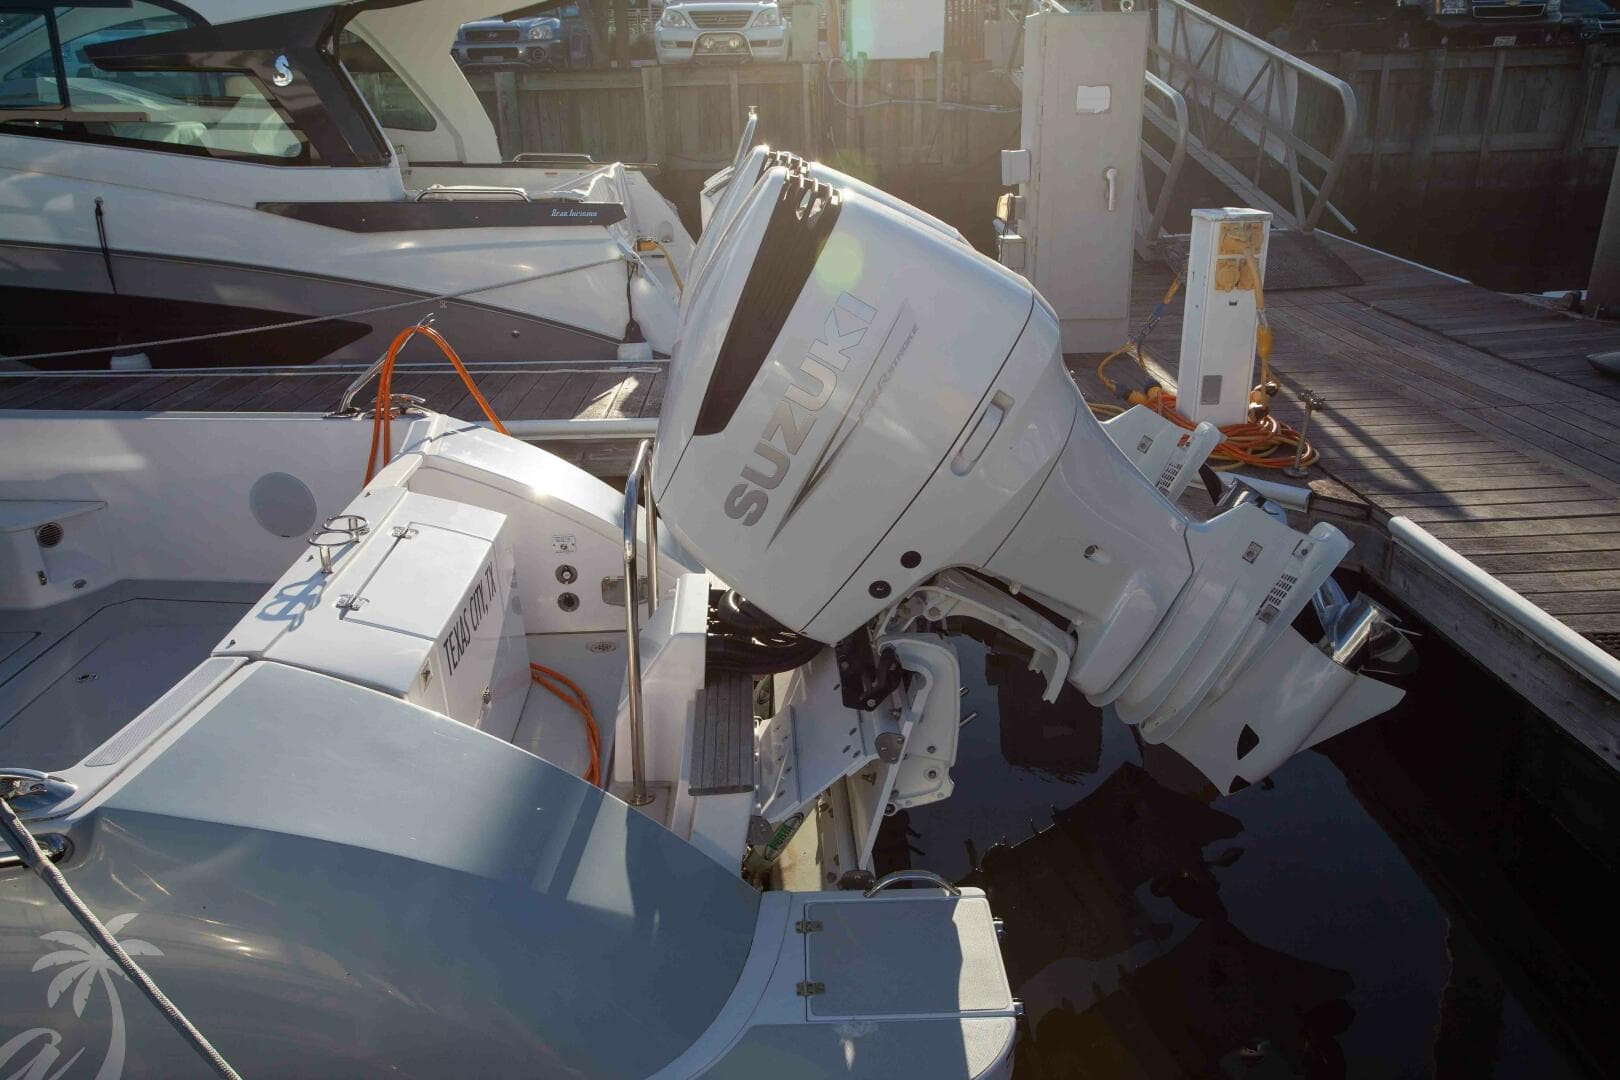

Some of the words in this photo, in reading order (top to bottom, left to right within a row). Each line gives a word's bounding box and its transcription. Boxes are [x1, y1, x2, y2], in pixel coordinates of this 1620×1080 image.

[723, 290, 879, 527] SUZUKI
[443, 607, 471, 677] TEXAS
[484, 561, 497, 602] TX
